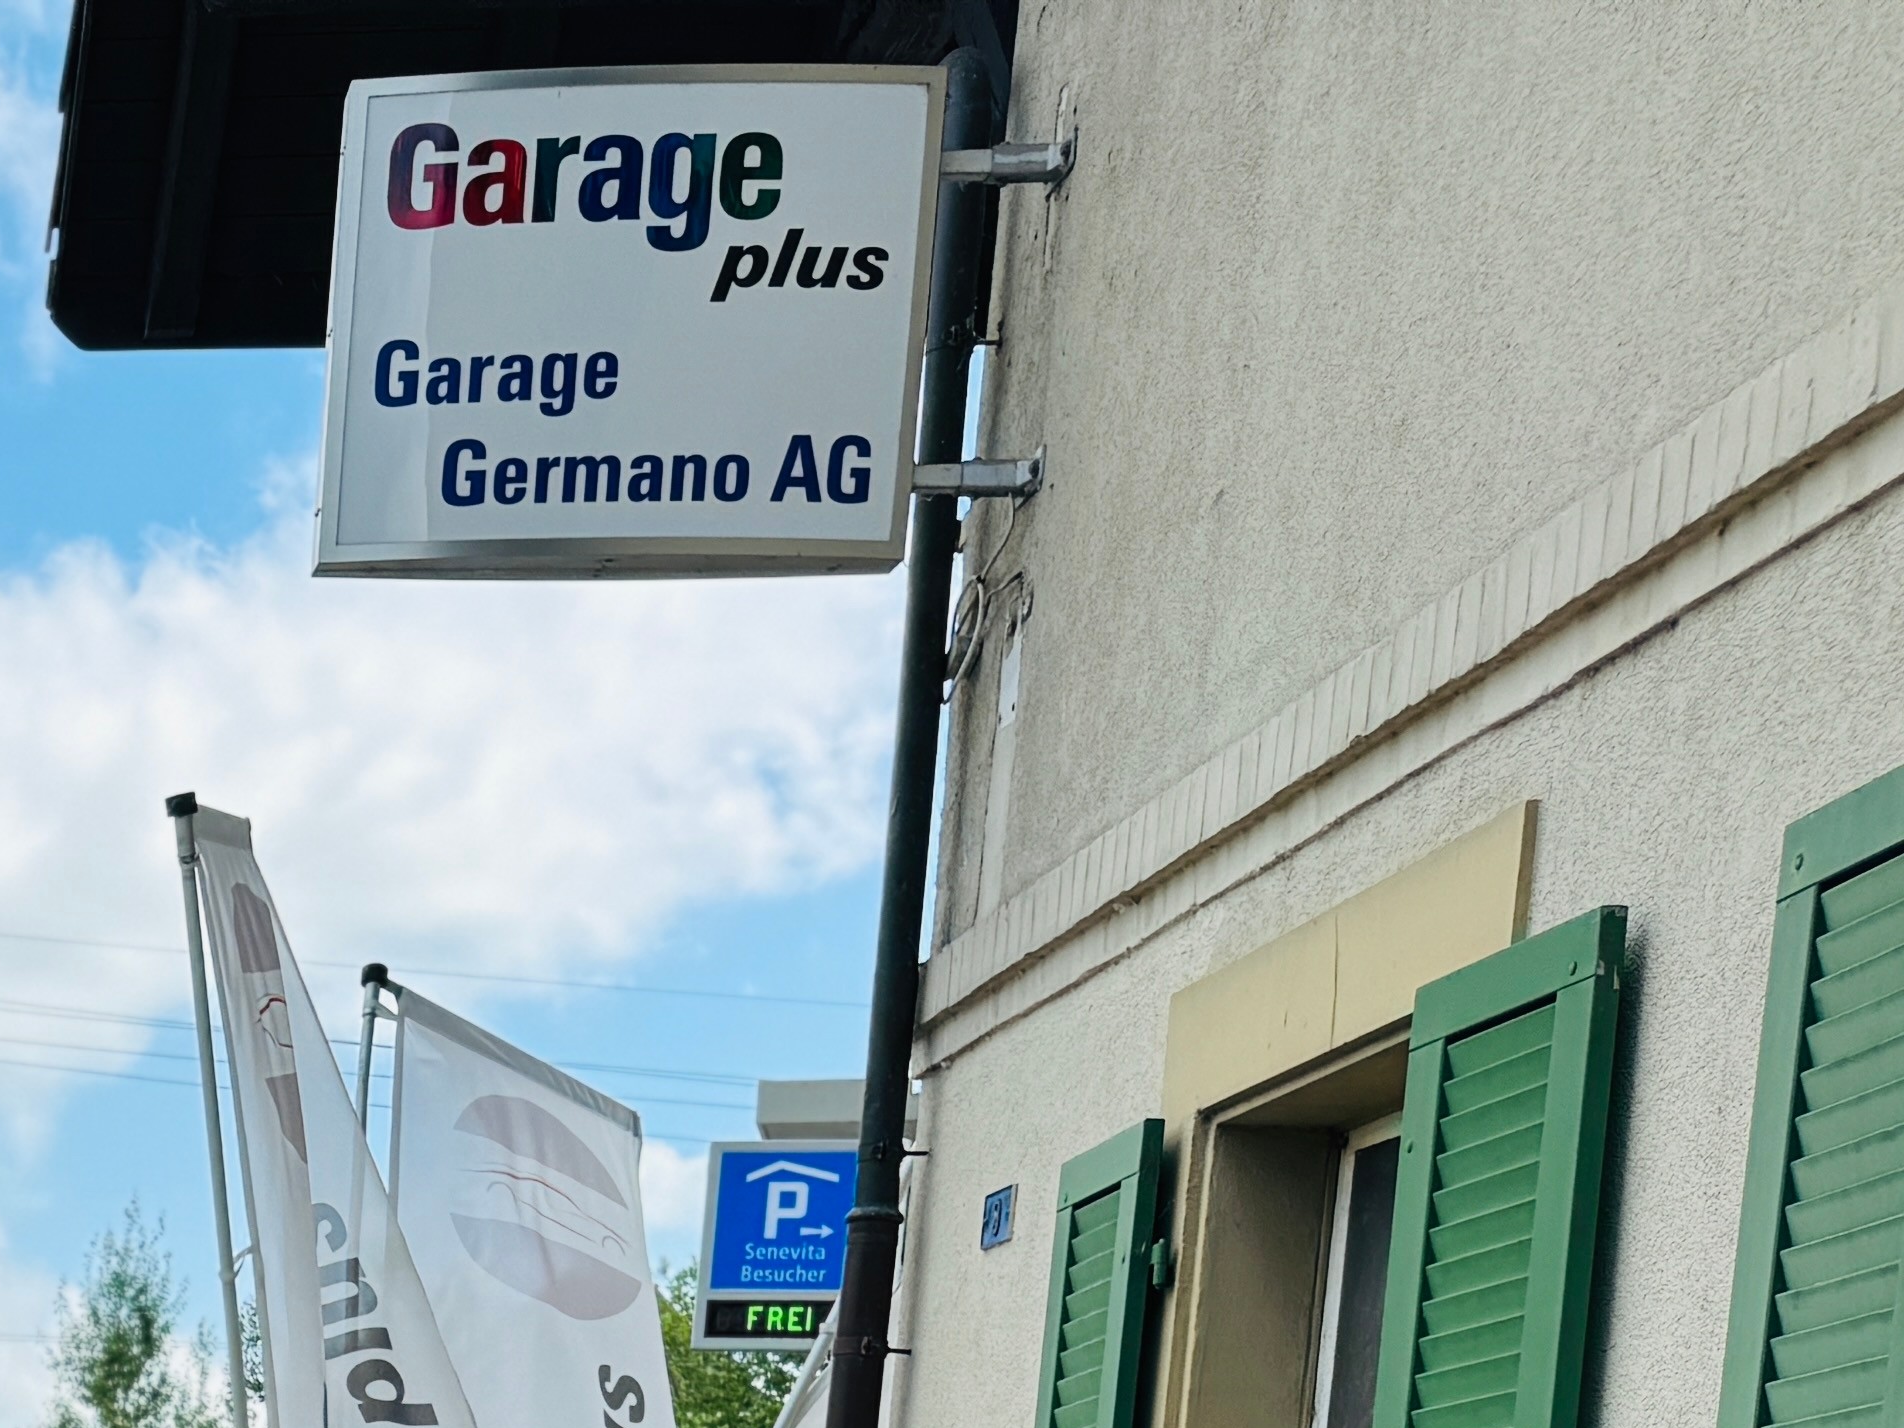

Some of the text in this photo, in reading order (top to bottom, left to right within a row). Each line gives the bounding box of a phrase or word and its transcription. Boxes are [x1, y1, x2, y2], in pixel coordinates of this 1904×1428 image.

[386, 121, 784, 252] Garage
[708, 228, 890, 303] plus
[373, 338, 620, 418] Garage
[440, 433, 873, 508] Germano AG
[740, 1264, 827, 1283] Besucher
[744, 1241, 827, 1261] Senevita
[746, 1305, 814, 1332] FREI
